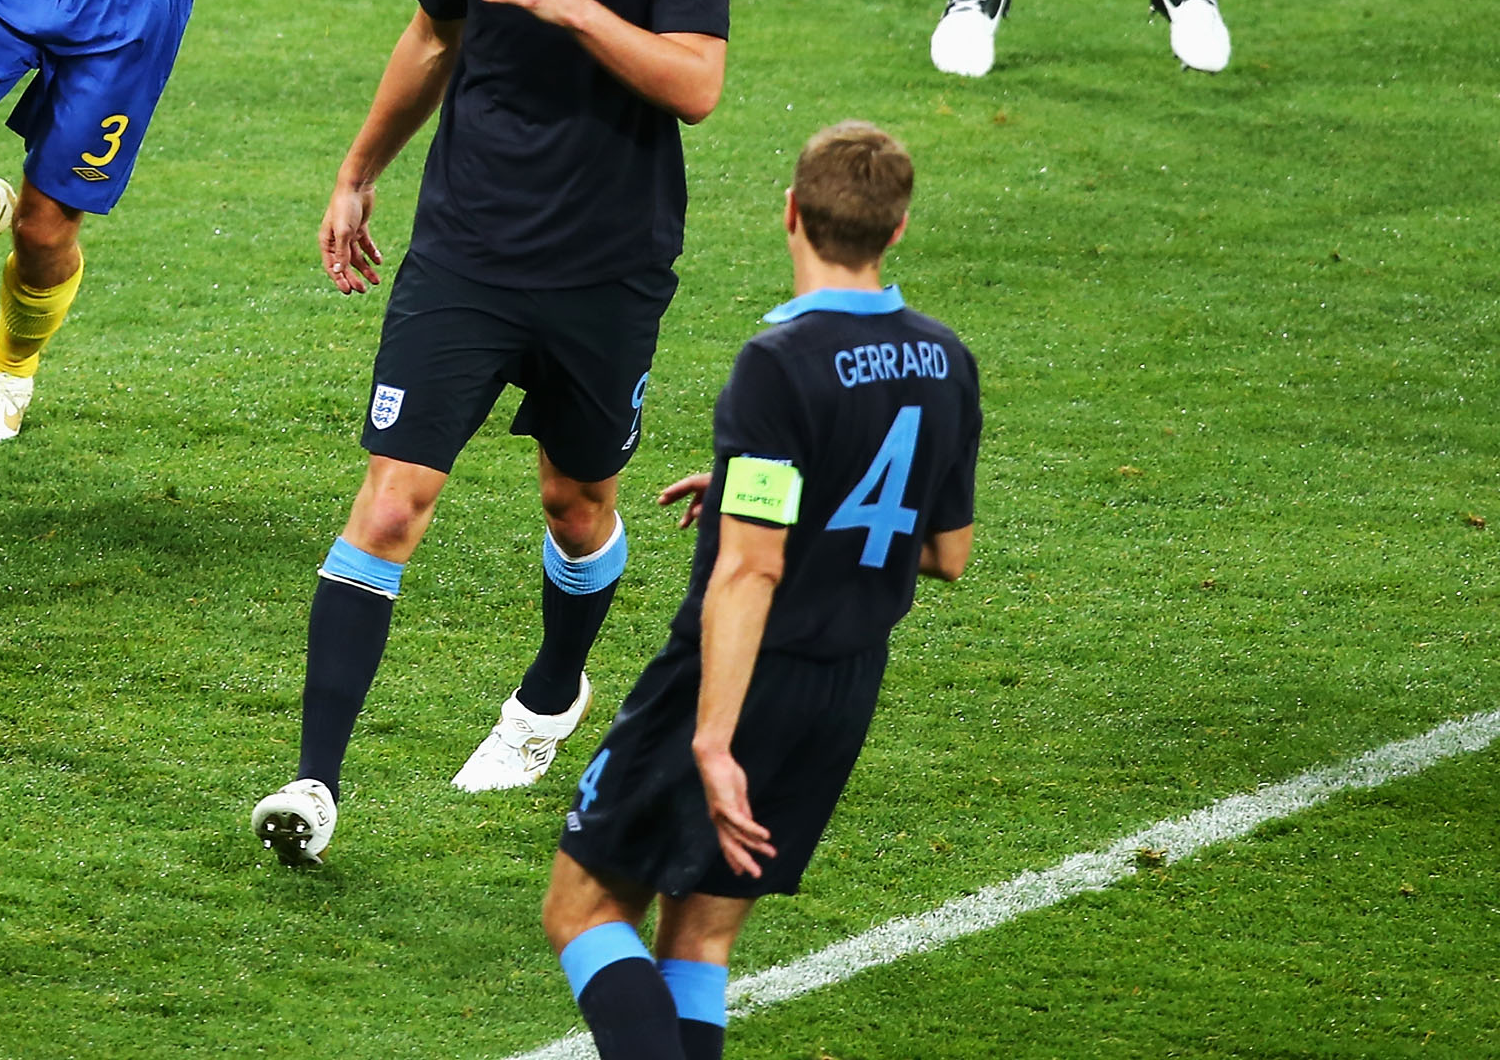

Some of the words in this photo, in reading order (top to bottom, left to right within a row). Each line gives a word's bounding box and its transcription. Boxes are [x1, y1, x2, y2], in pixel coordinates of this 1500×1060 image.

[81, 114, 129, 167] 3
[834, 340, 950, 389] GERRARD
[631, 371, 649, 432] 9
[825, 405, 923, 569] 4
[578, 747, 612, 813] 4
